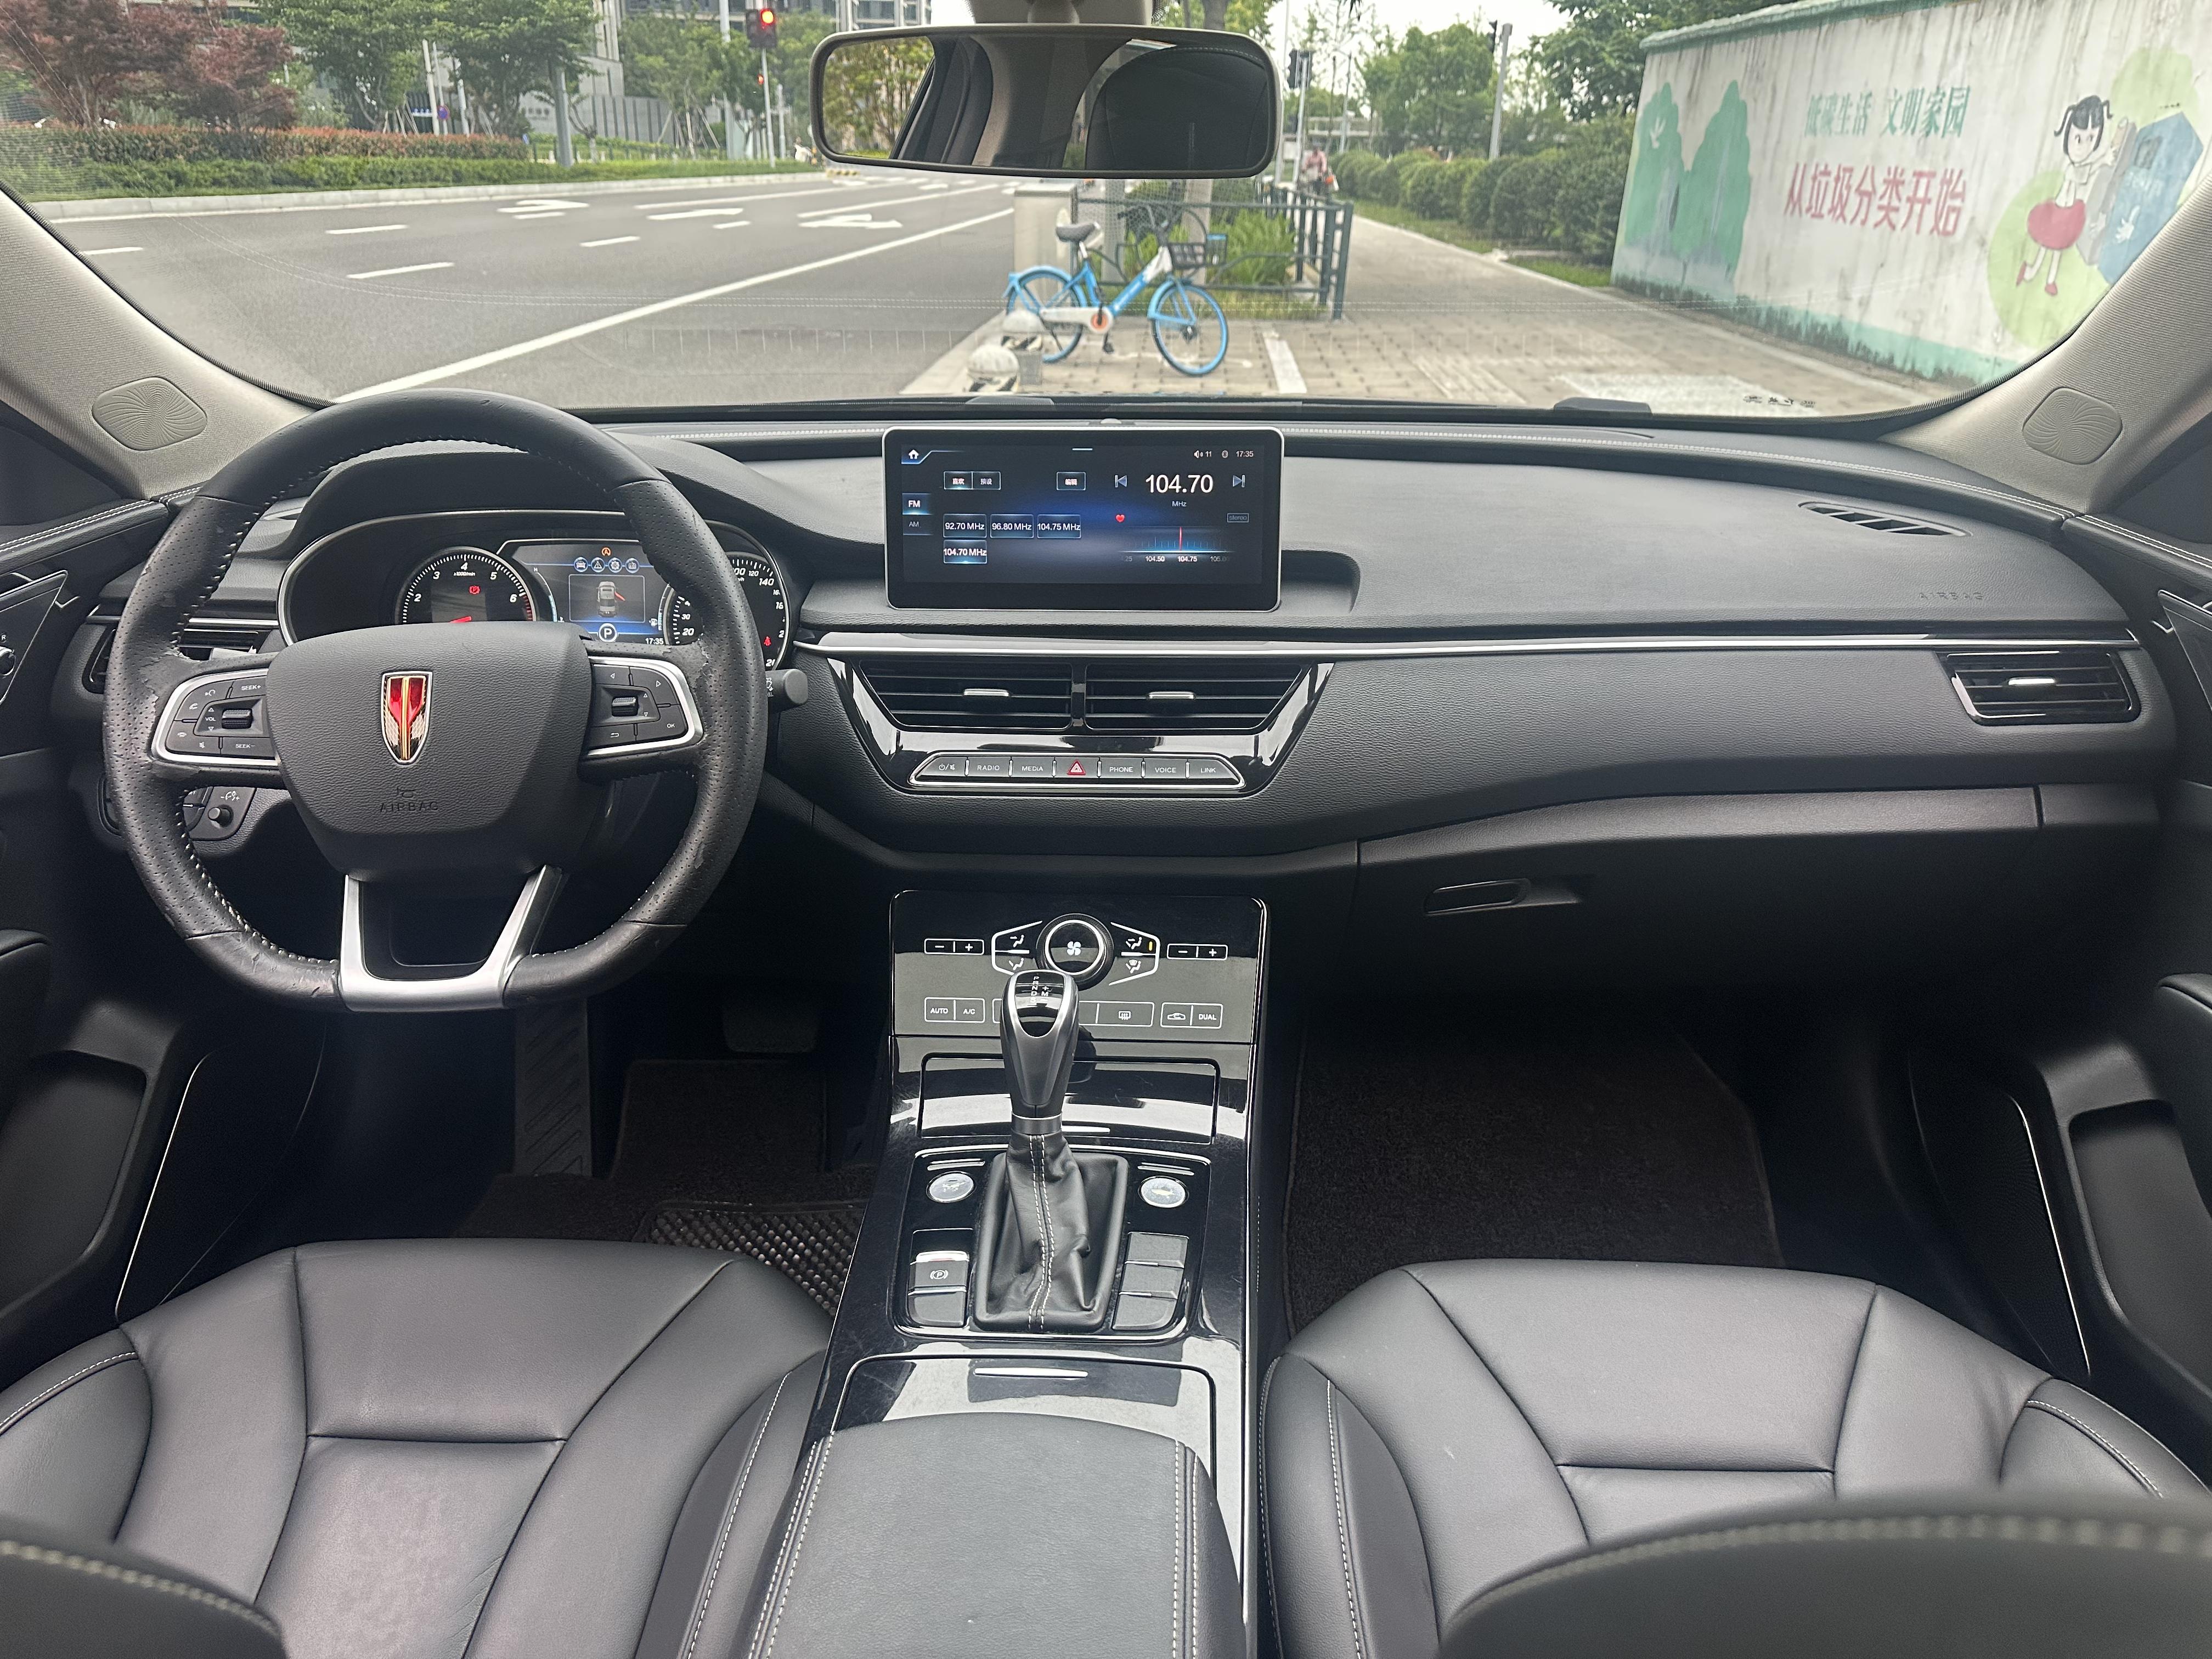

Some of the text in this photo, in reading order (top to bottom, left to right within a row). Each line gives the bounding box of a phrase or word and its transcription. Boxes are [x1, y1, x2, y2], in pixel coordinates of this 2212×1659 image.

[1880, 84, 1971, 139] 文明家园
[1784, 162, 1967, 238] 从垃圾分类开始
[1145, 474, 1214, 493] 104.70
[460, 562, 469, 571] 4
[733, 567, 746, 575] 00
[433, 571, 441, 580] 3
[490, 571, 498, 580] 5
[759, 578, 775, 586] 140
[414, 594, 422, 602] 2
[509, 594, 517, 603] 6
[603, 628, 612, 639] P
[682, 628, 695, 636] 20
[380, 801, 439, 812] AIRBAG
